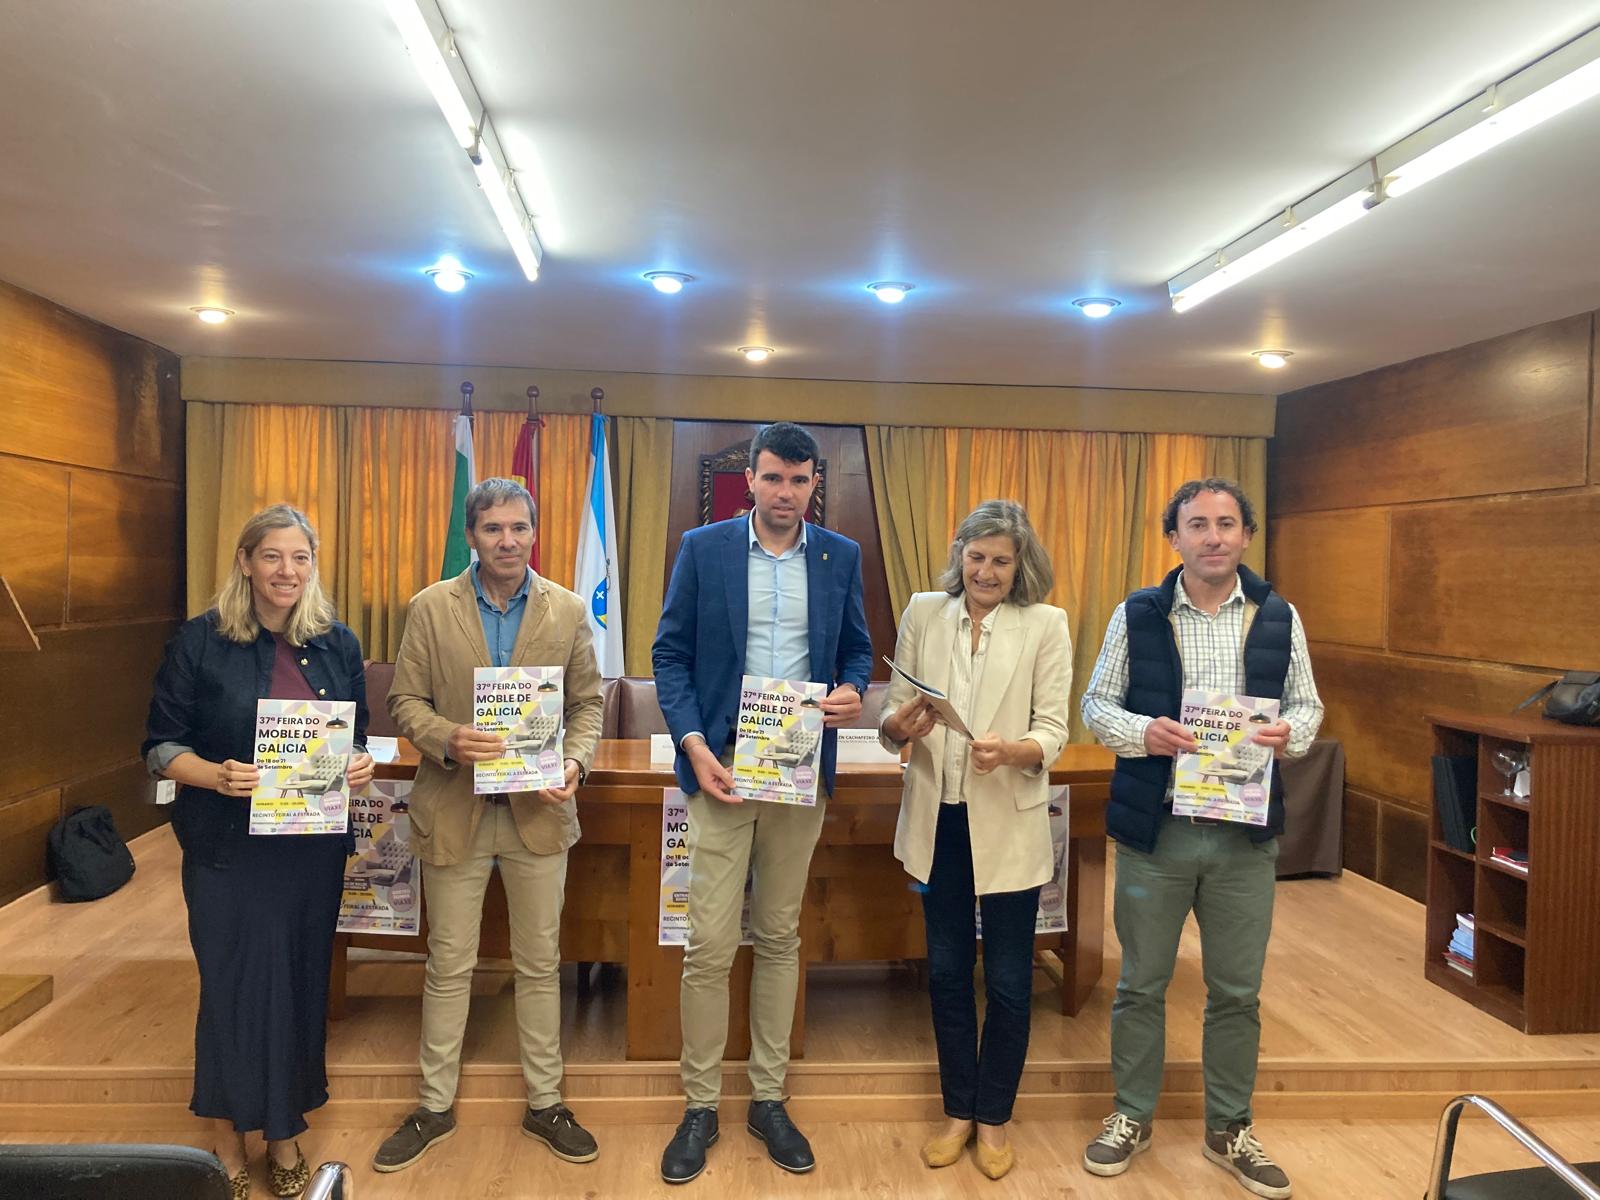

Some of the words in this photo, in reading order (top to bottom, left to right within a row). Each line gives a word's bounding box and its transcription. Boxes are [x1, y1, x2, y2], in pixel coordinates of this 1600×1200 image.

[476, 694, 516, 704] MOBLE
[518, 694, 531, 702] DE
[758, 692, 780, 702] FEIRA
[476, 708, 522, 716] GALICIA
[742, 702, 779, 714] MOBLE
[780, 706, 794, 716] DE
[1202, 708, 1226, 717] FEIRA
[277, 717, 304, 725] FEIRA
[741, 715, 784, 728] GALICIA
[1184, 717, 1223, 729] MOBLE
[1226, 722, 1241, 730] DE
[258, 729, 300, 738] MOBLE
[303, 730, 318, 738] DE
[1193, 731, 1230, 742] ALICIA
[258, 744, 308, 754] GALICIA
[349, 800, 367, 808] EIRA
[368, 813, 383, 824] DE
